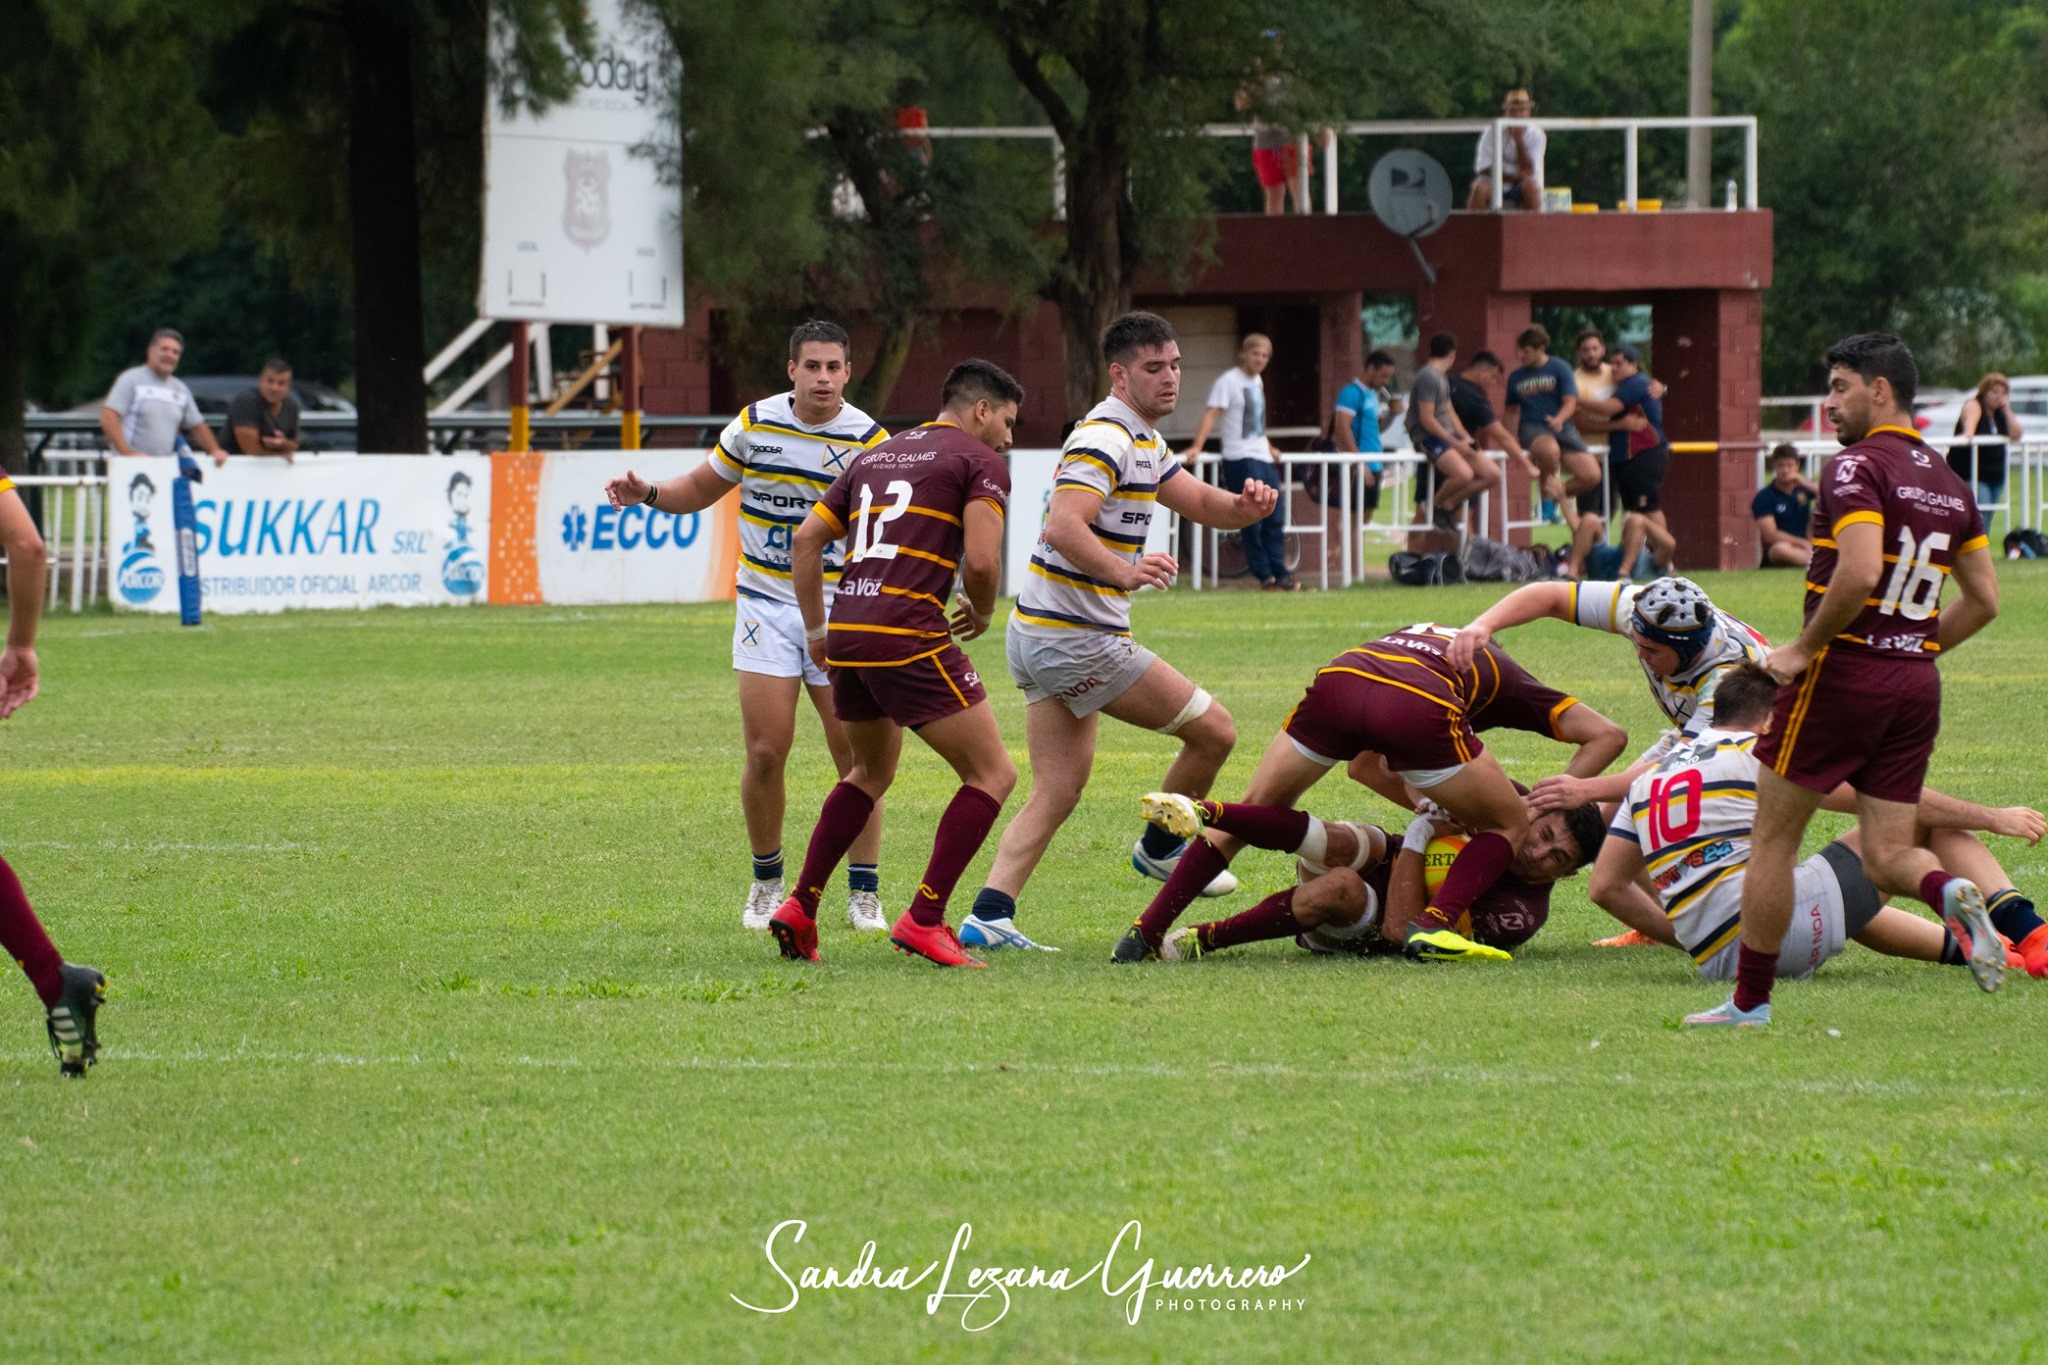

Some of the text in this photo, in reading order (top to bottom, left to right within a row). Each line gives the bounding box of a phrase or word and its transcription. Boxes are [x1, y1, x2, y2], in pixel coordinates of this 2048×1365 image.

[861, 451, 938, 466] GRUPO GALMES
[193, 499, 380, 557] SUKKAR
[391, 529, 428, 555] SRL
[591, 504, 700, 551] ECCO
[851, 480, 913, 563] 12
[201, 573, 423, 596] STRIBUIDOR OFICIAL ARCOR
[856, 577, 882, 597] Voz
[1878, 525, 1951, 620] 16
[1648, 768, 1703, 851] 10
